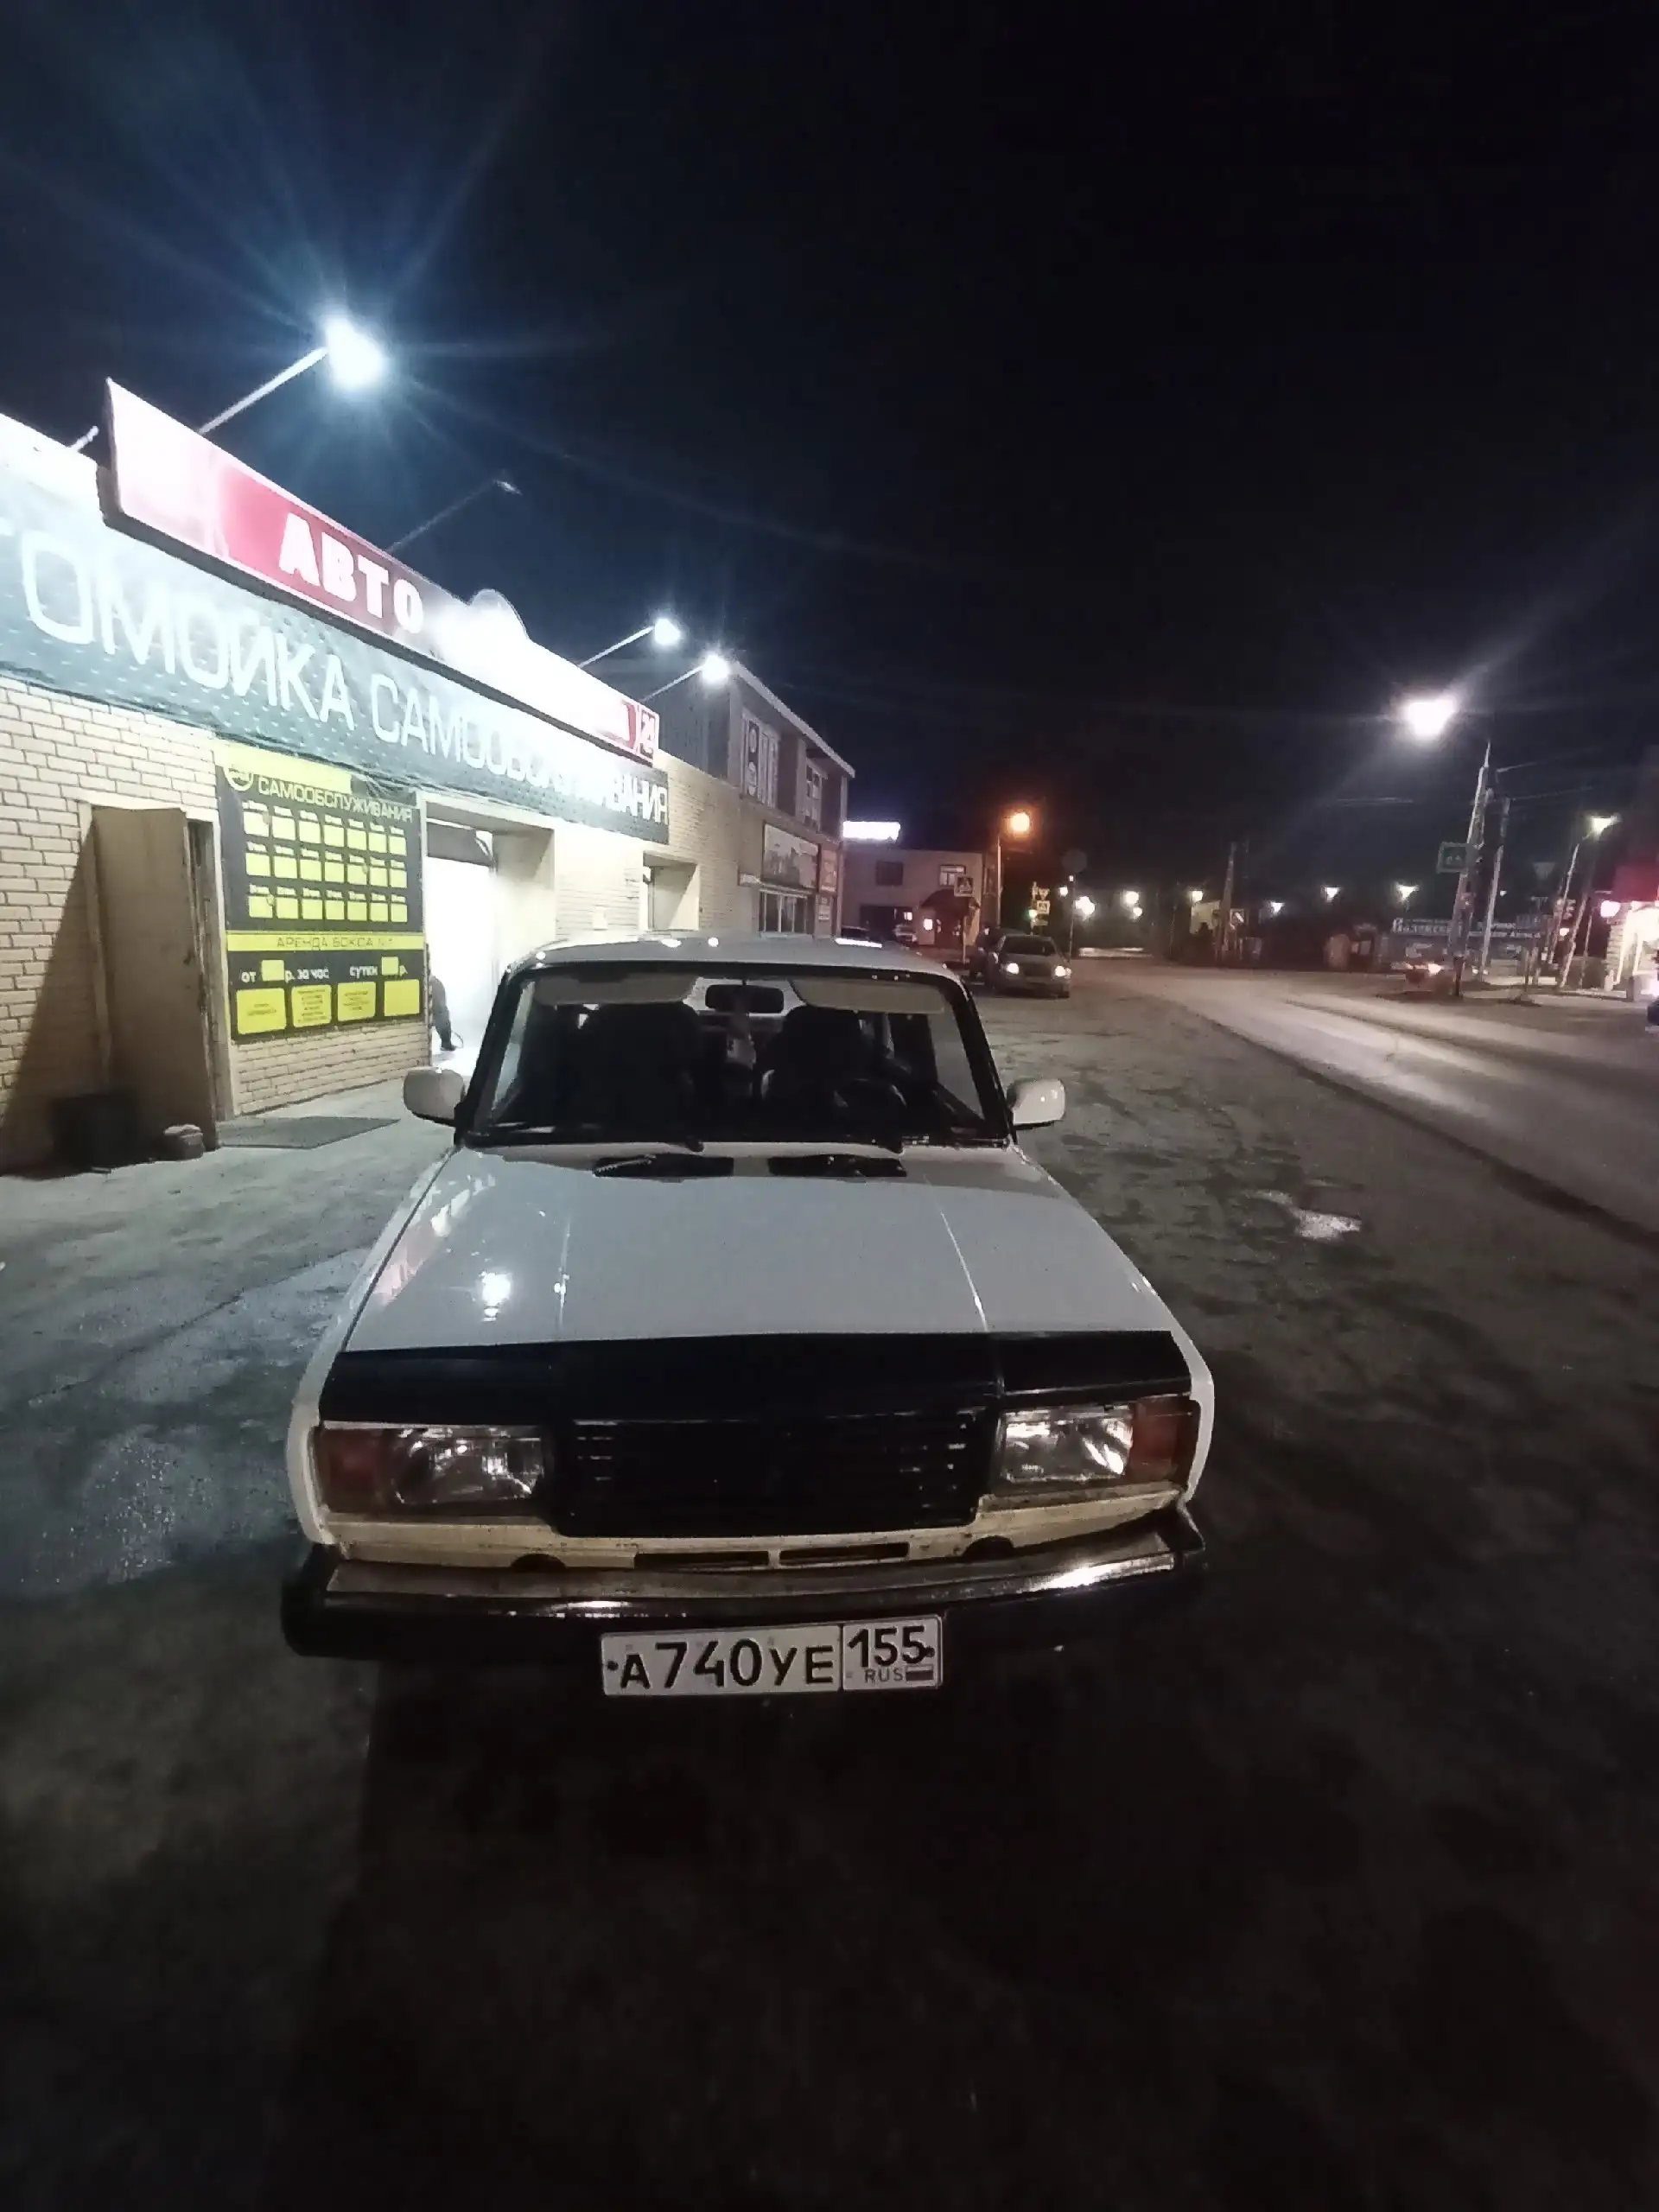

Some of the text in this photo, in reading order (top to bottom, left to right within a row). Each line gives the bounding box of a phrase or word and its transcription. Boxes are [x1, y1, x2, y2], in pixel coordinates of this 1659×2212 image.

[279, 512, 423, 634] АВТО
[0, 517, 355, 731] ОМОЙКА
[258, 777, 413, 823] САМООБСЛУЖИВАНИЯ
[847, 1624, 926, 1669] 155
[864, 1668, 904, 1684] RUS
